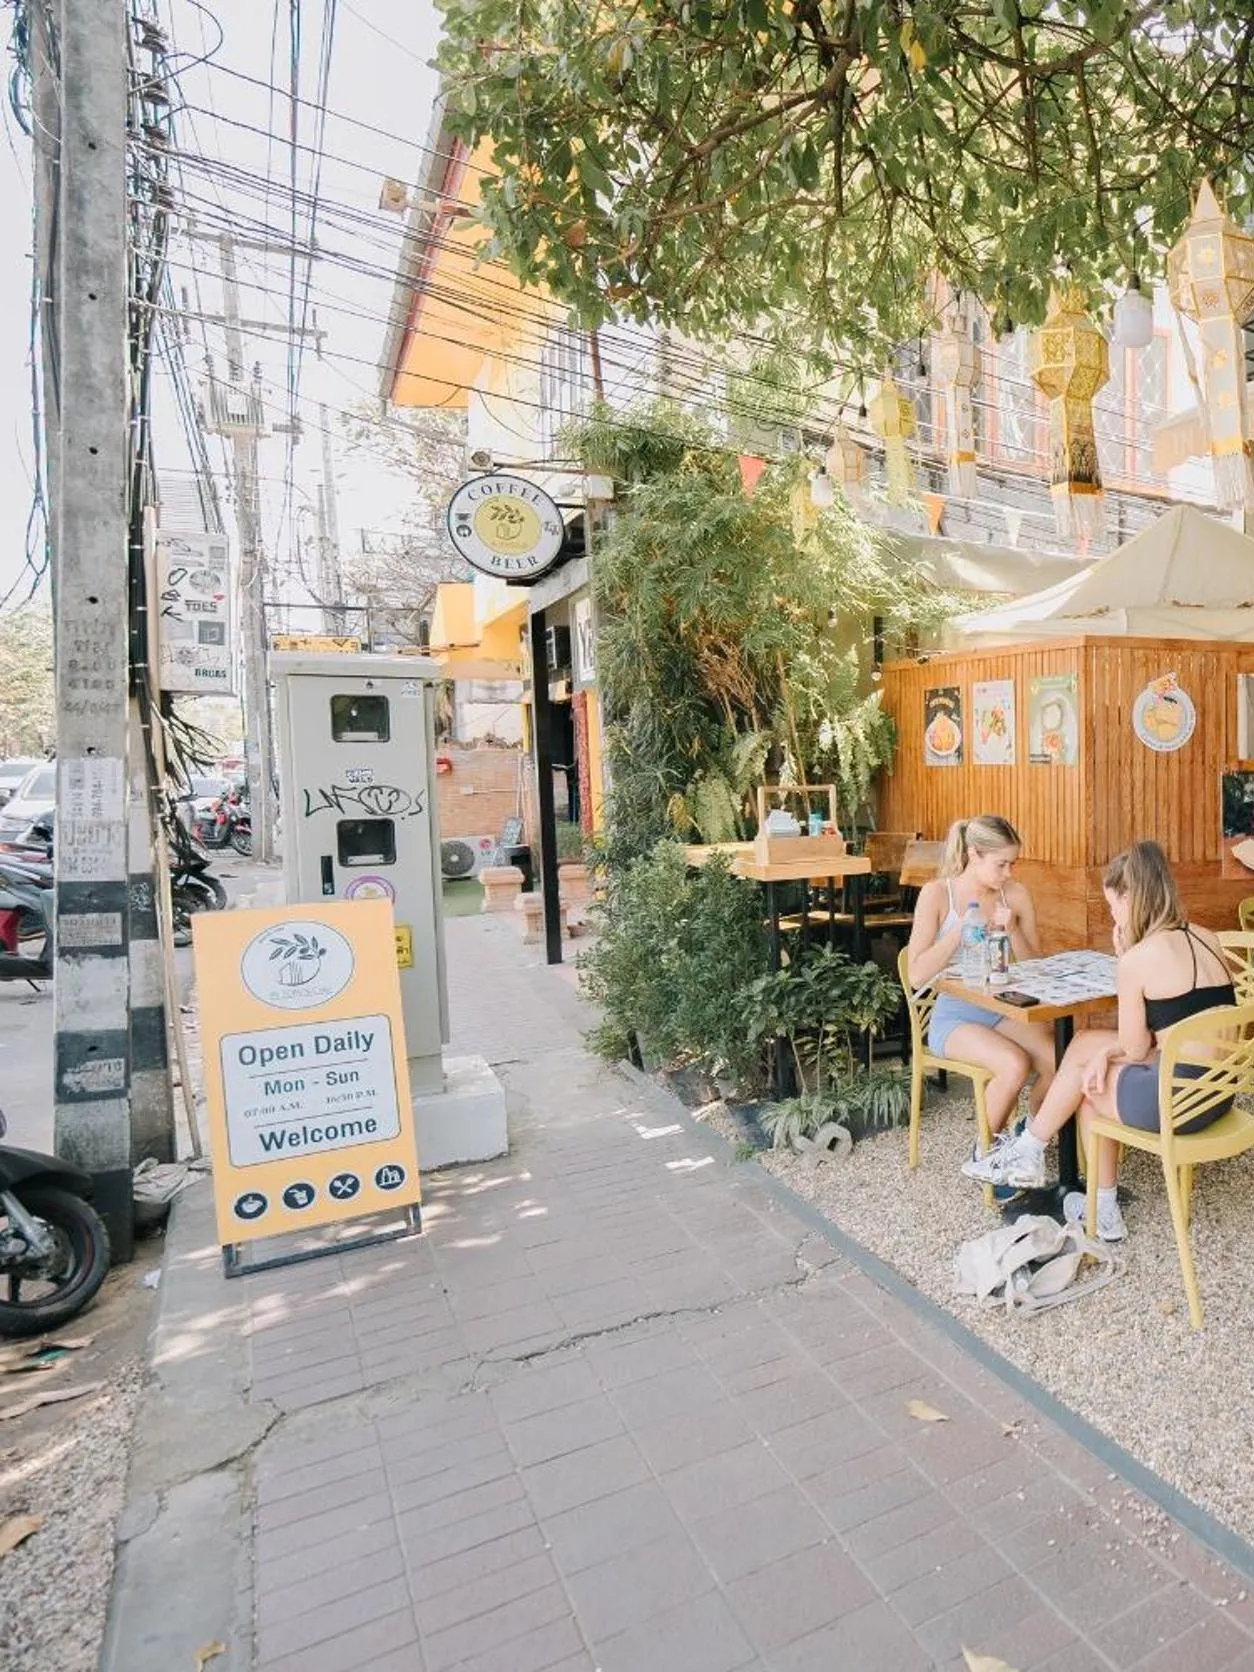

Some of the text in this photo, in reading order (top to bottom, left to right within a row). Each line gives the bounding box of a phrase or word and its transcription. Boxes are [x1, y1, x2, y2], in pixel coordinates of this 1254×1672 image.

[468, 482, 543, 507] COFFEE
[490, 555, 538, 569] BEER
[238, 1030, 375, 1067] Open Daily
[264, 1079, 305, 1096] Mon
[325, 1070, 360, 1086] Sun
[259, 1117, 377, 1152] Welcome
